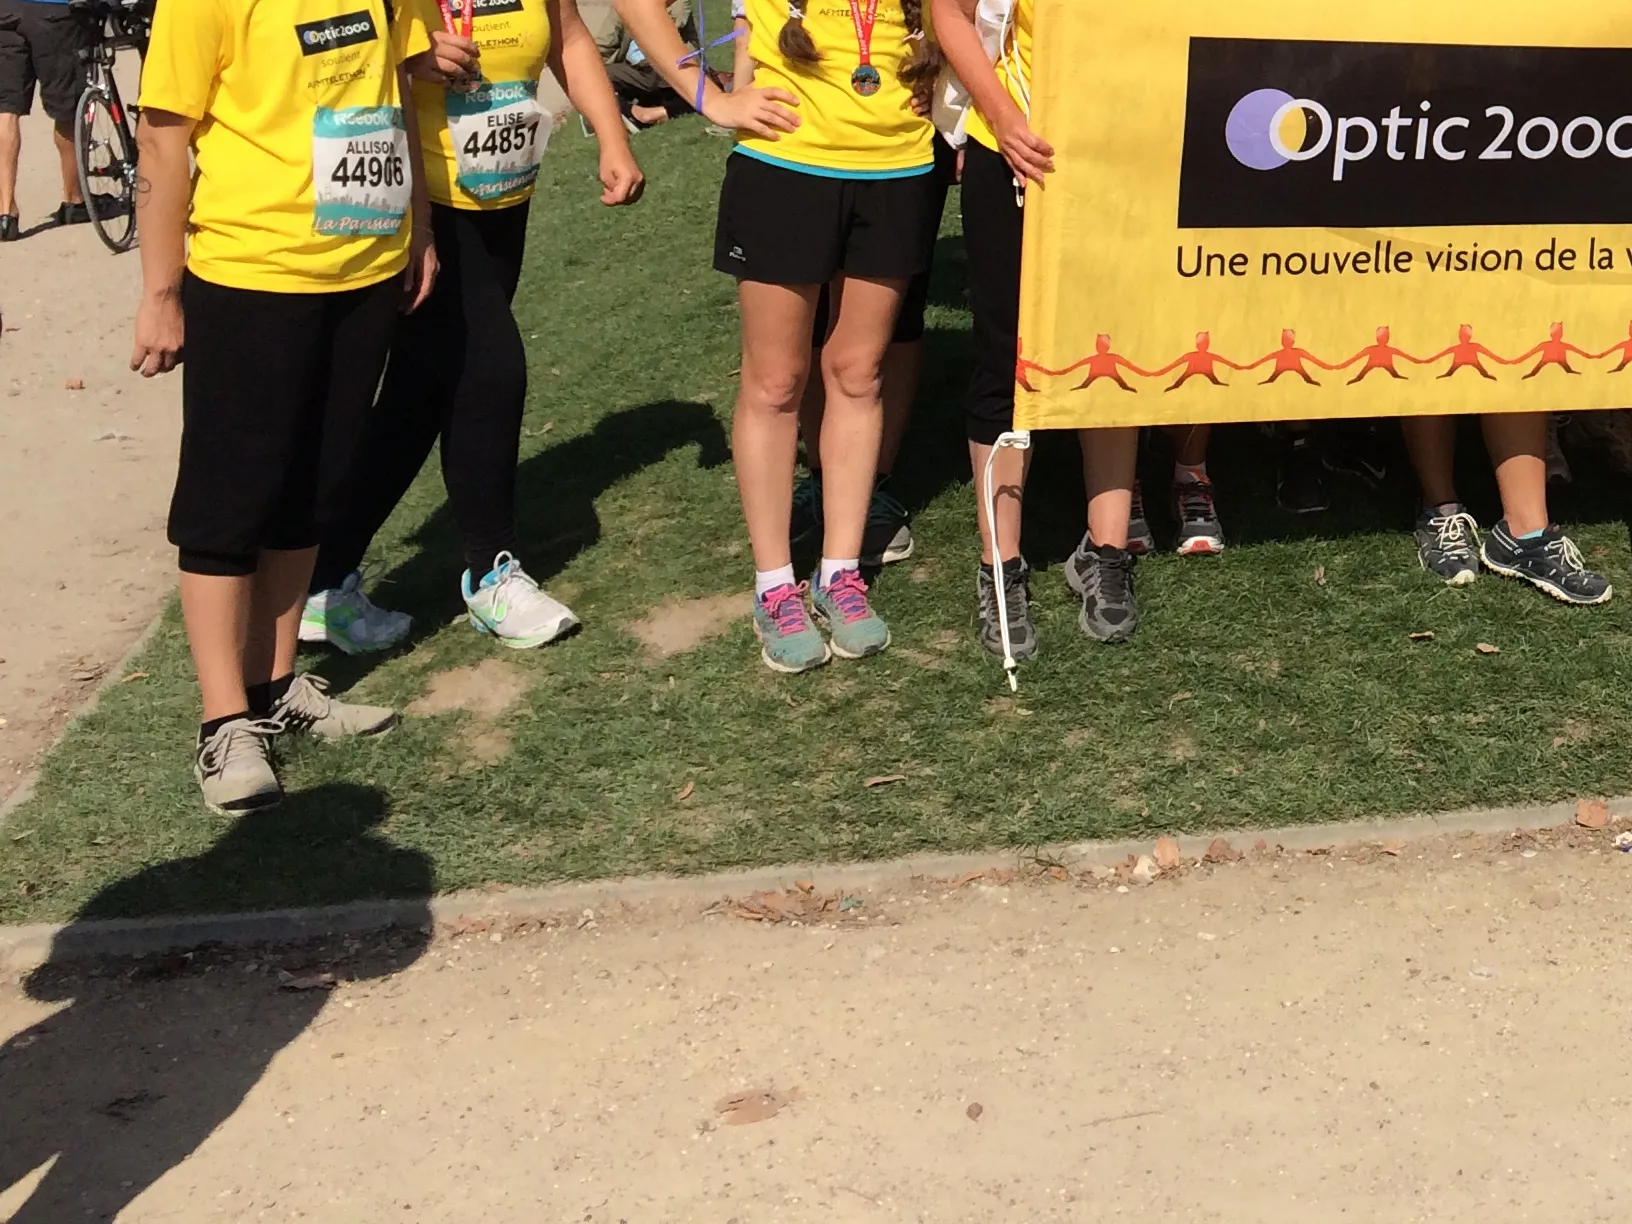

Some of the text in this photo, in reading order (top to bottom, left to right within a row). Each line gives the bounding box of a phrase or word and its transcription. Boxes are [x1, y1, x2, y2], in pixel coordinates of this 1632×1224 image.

[472, 21, 512, 33] outient
[321, 50, 362, 68] soutient
[465, 85, 524, 104] Reebok
[334, 110, 389, 126] Reebok
[487, 112, 524, 128] ELISE
[346, 141, 395, 155] ALLISON
[463, 120, 540, 158] 44851
[1269, 98, 1469, 181] Optic
[331, 156, 405, 188] 44906
[1177, 245, 1249, 279] Une
[1261, 240, 1414, 276] nouvelle
[1426, 240, 1523, 273] vision
[1535, 237, 1577, 272] de
[1589, 238, 1617, 271] la
